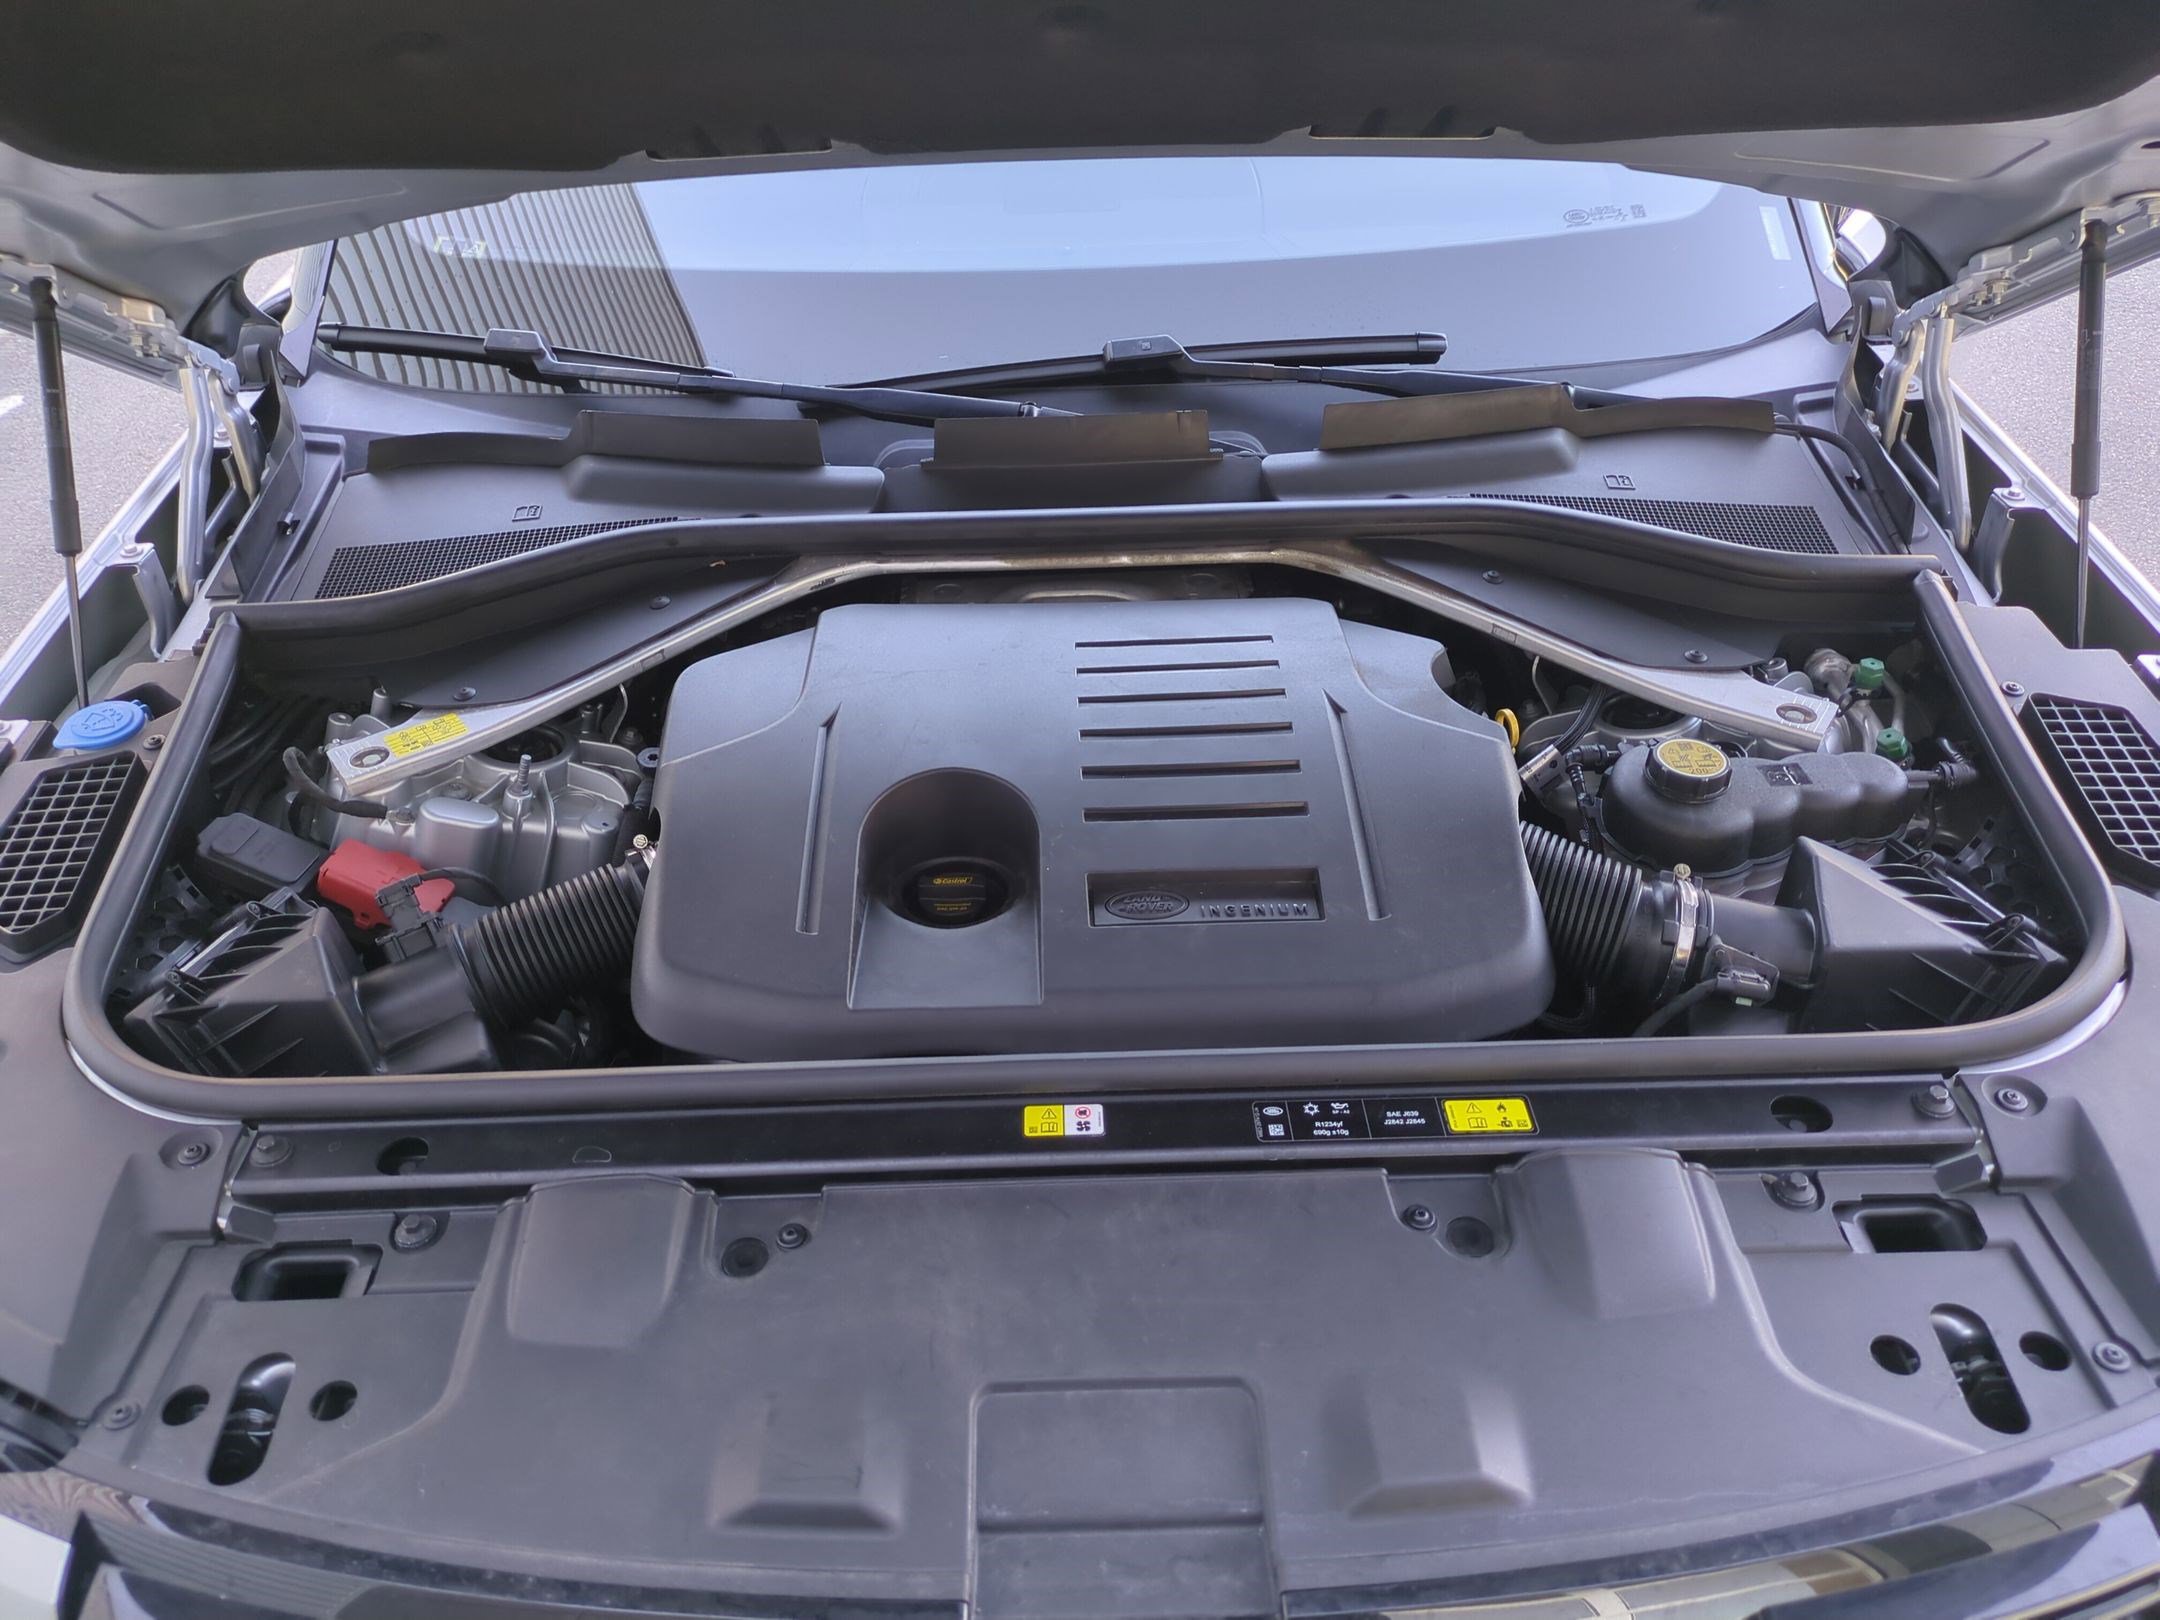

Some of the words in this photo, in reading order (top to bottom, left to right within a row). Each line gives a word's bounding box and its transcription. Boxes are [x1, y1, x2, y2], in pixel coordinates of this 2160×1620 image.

[942, 877, 968, 885] Castrol
[1122, 896, 1161, 904] LAND
[1125, 901, 1174, 913] ROVER
[1200, 903, 1308, 918] INGENIUM
